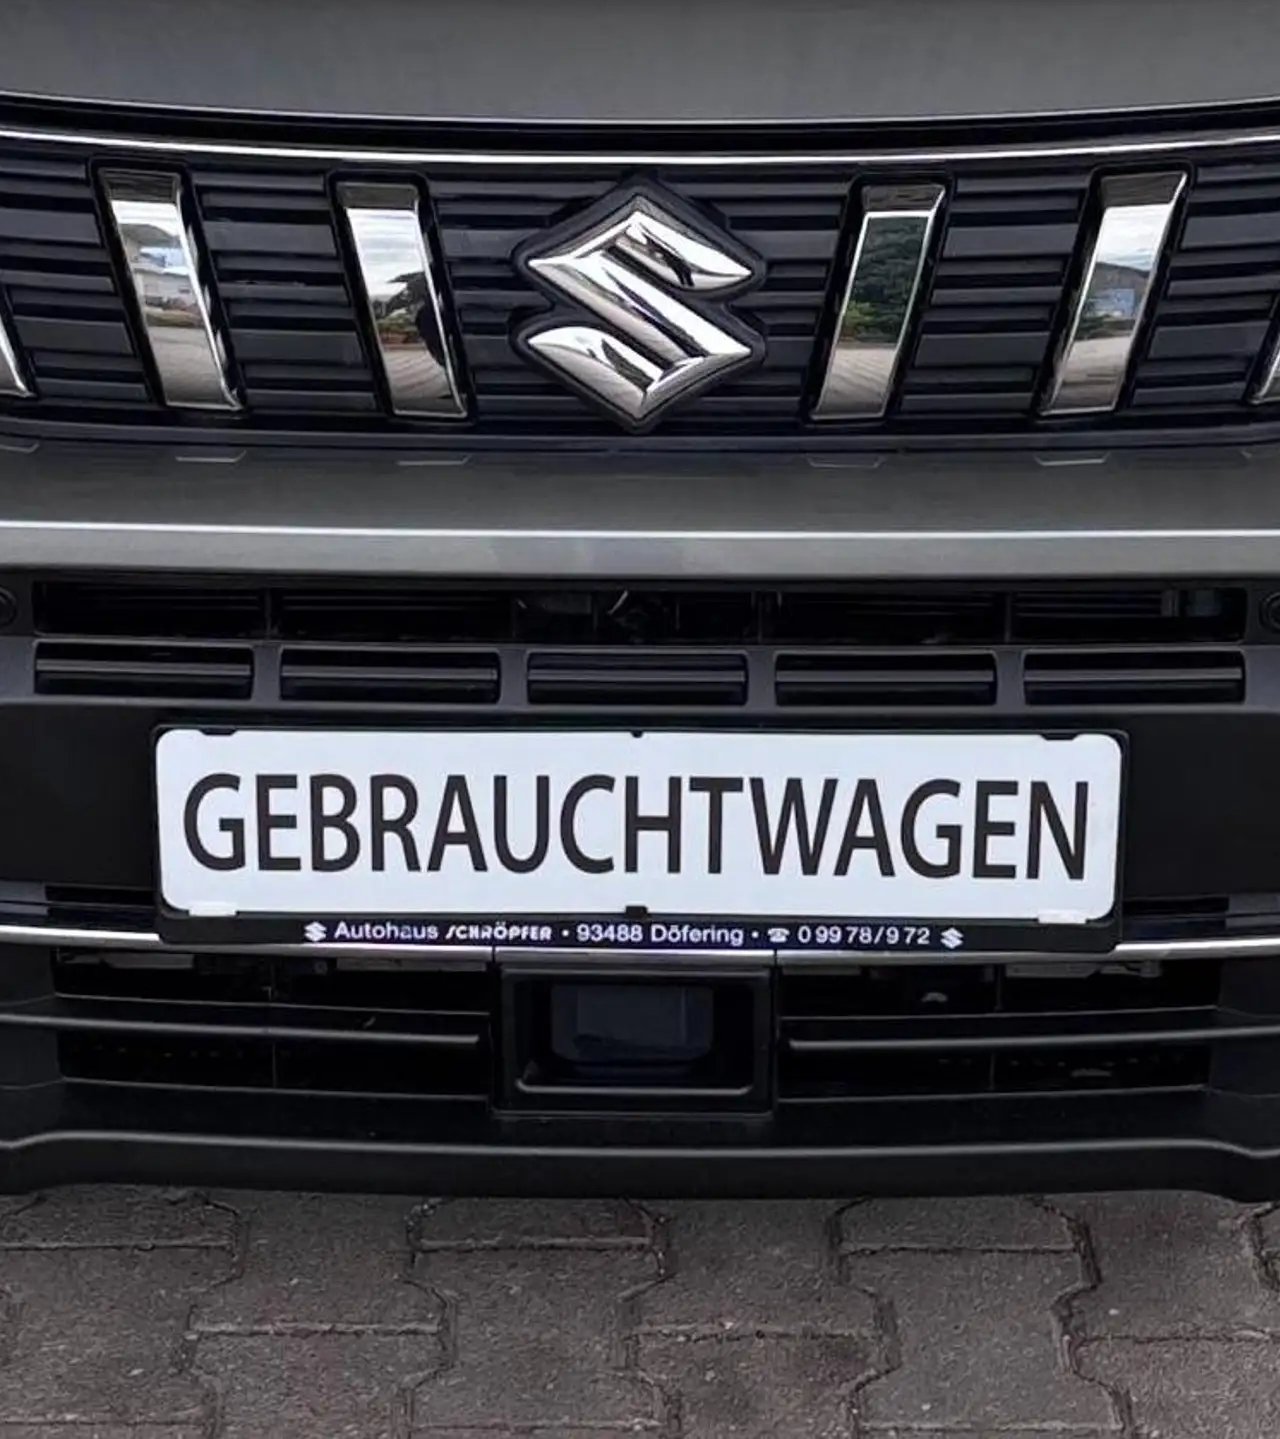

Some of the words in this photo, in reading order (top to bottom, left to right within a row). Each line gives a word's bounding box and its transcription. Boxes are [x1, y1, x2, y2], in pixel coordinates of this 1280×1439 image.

[182, 772, 1090, 881] GEBRAUCHTWAGEN
[333, 921, 439, 941] Autohaus
[445, 921, 552, 941] SCHRÖPFER
[576, 924, 643, 943] 93488
[651, 924, 745, 946] Döfering
